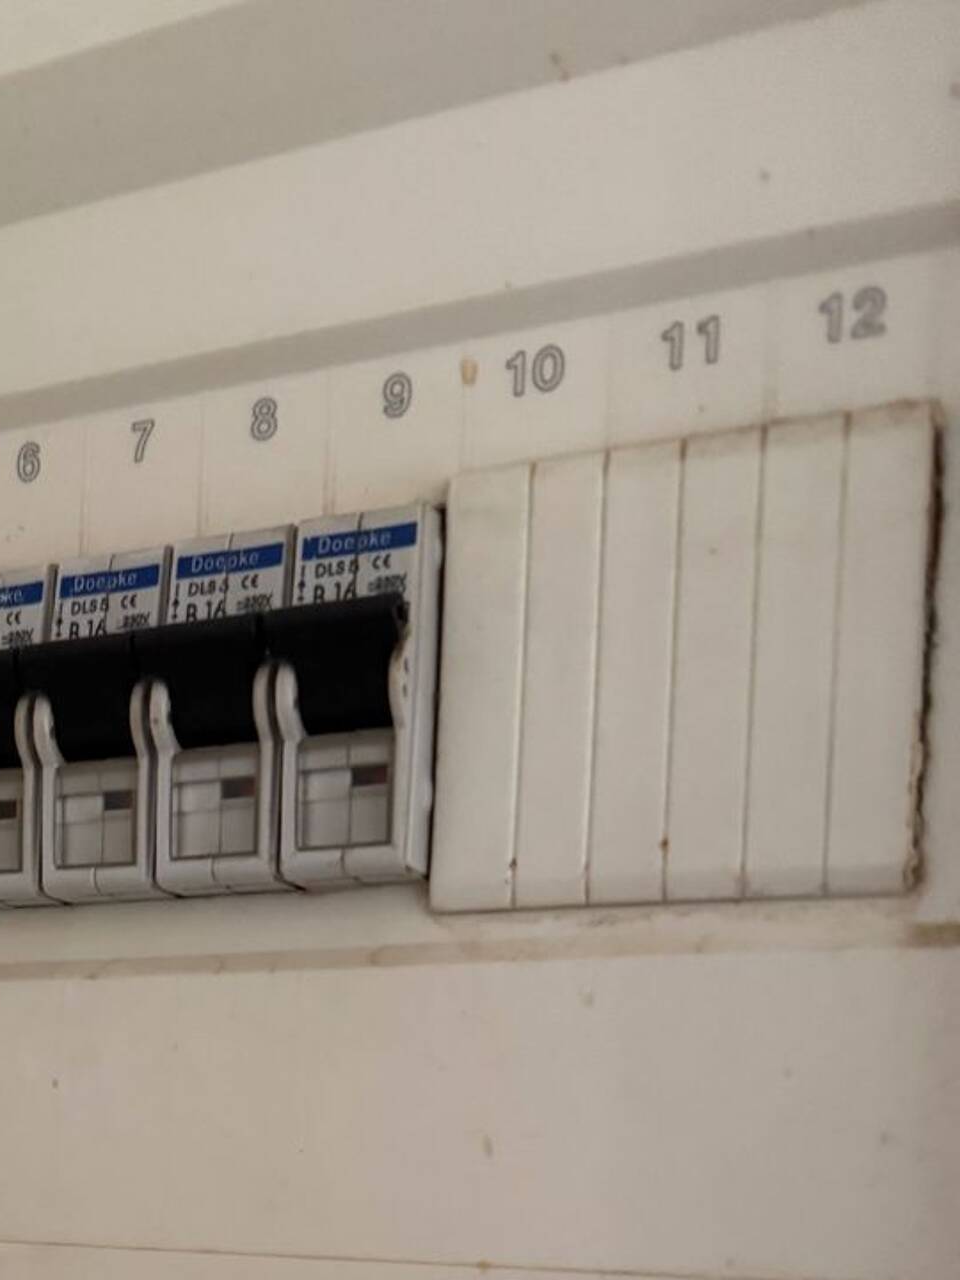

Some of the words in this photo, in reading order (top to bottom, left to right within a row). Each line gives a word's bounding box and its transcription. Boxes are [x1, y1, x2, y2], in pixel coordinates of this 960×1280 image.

[818, 285, 889, 345] 12
[661, 315, 721, 371] 11
[506, 343, 566, 398] 10
[382, 371, 412, 419] 9
[250, 396, 278, 441] 8
[16, 441, 41, 483] 6
[130, 419, 155, 464] 7
[192, 550, 259, 573] Doepke
[318, 530, 392, 555] Doepke
[74, 570, 138, 592] Doepke
